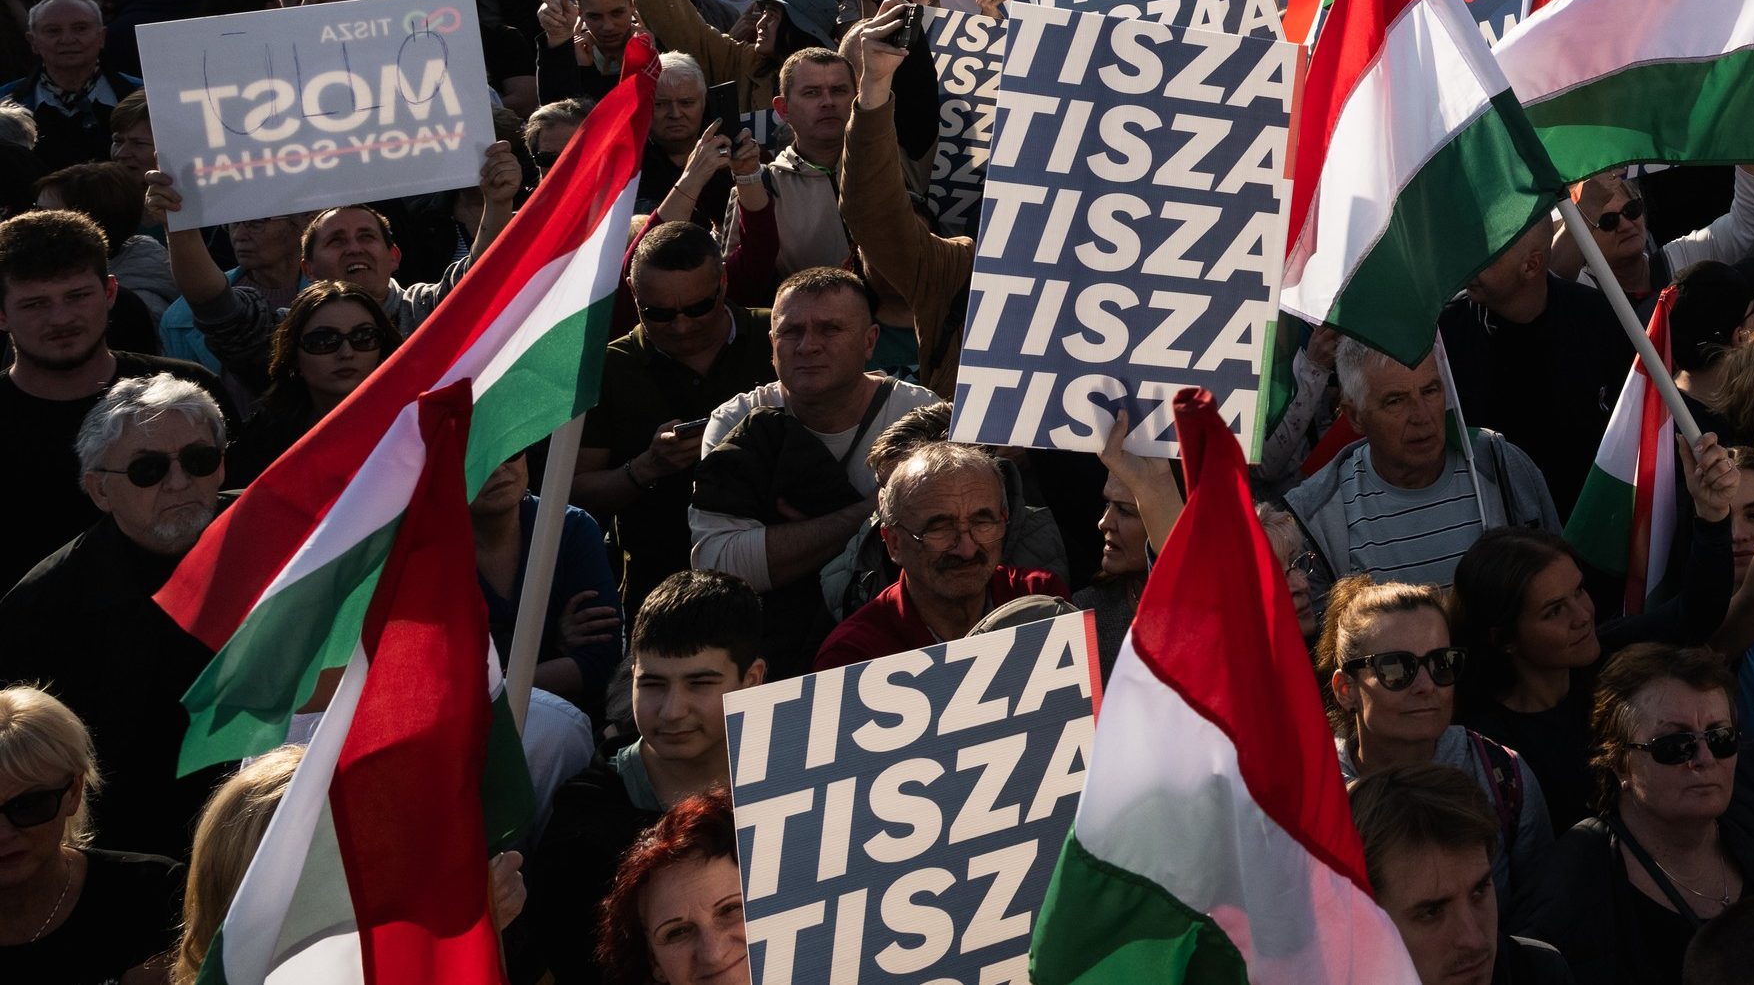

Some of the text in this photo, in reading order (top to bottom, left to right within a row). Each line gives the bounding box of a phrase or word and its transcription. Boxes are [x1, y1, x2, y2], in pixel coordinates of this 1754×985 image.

[1003, 2, 1300, 113] TISZA
[990, 92, 1289, 199] TISZA
[976, 181, 1280, 286] TISZA
[962, 271, 1272, 376] TISZA
[726, 613, 1092, 788] TISZA
[735, 717, 1092, 902] TISZA
[747, 838, 1041, 985] TISZ
